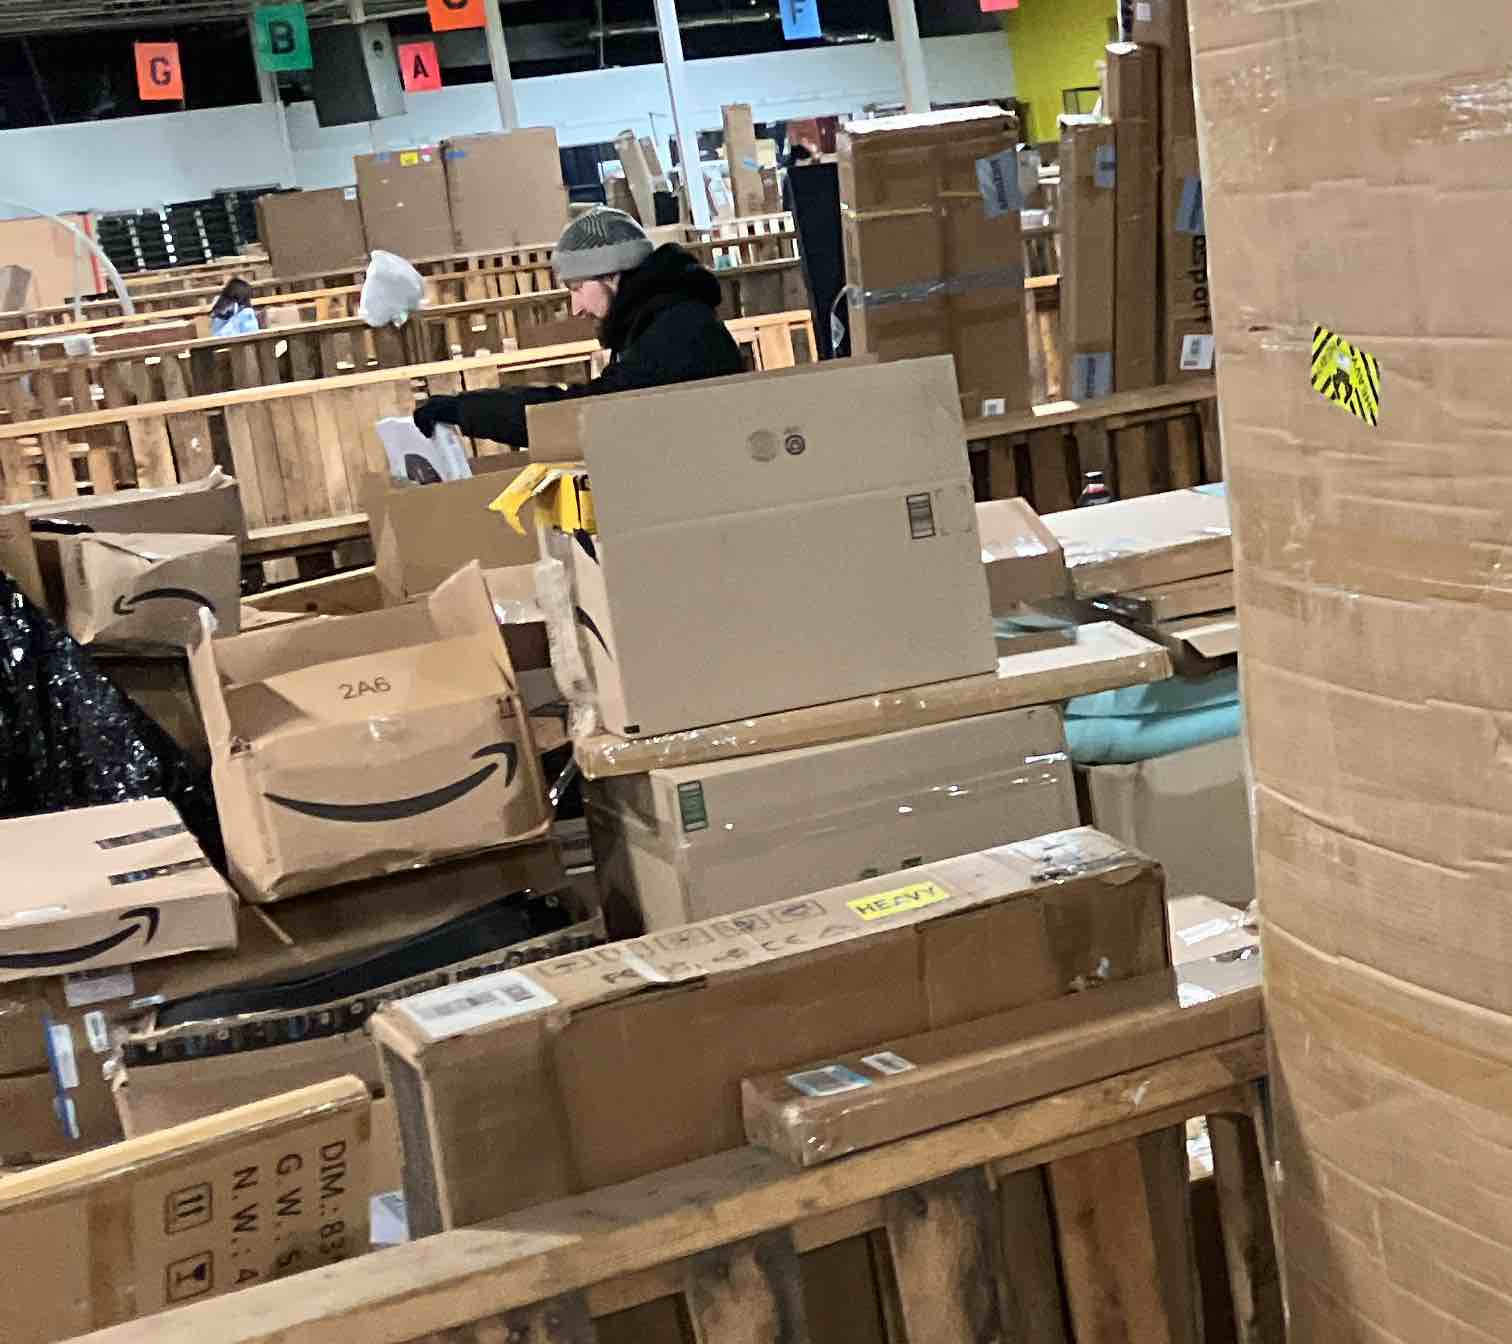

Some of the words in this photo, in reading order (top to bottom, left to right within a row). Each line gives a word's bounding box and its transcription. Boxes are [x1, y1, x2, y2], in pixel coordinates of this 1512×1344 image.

[270, 21, 295, 55] B
[150, 58, 171, 85] G
[412, 53, 429, 81] A
[338, 676, 392, 701] 2A6
[853, 884, 940, 917] HEAVY
